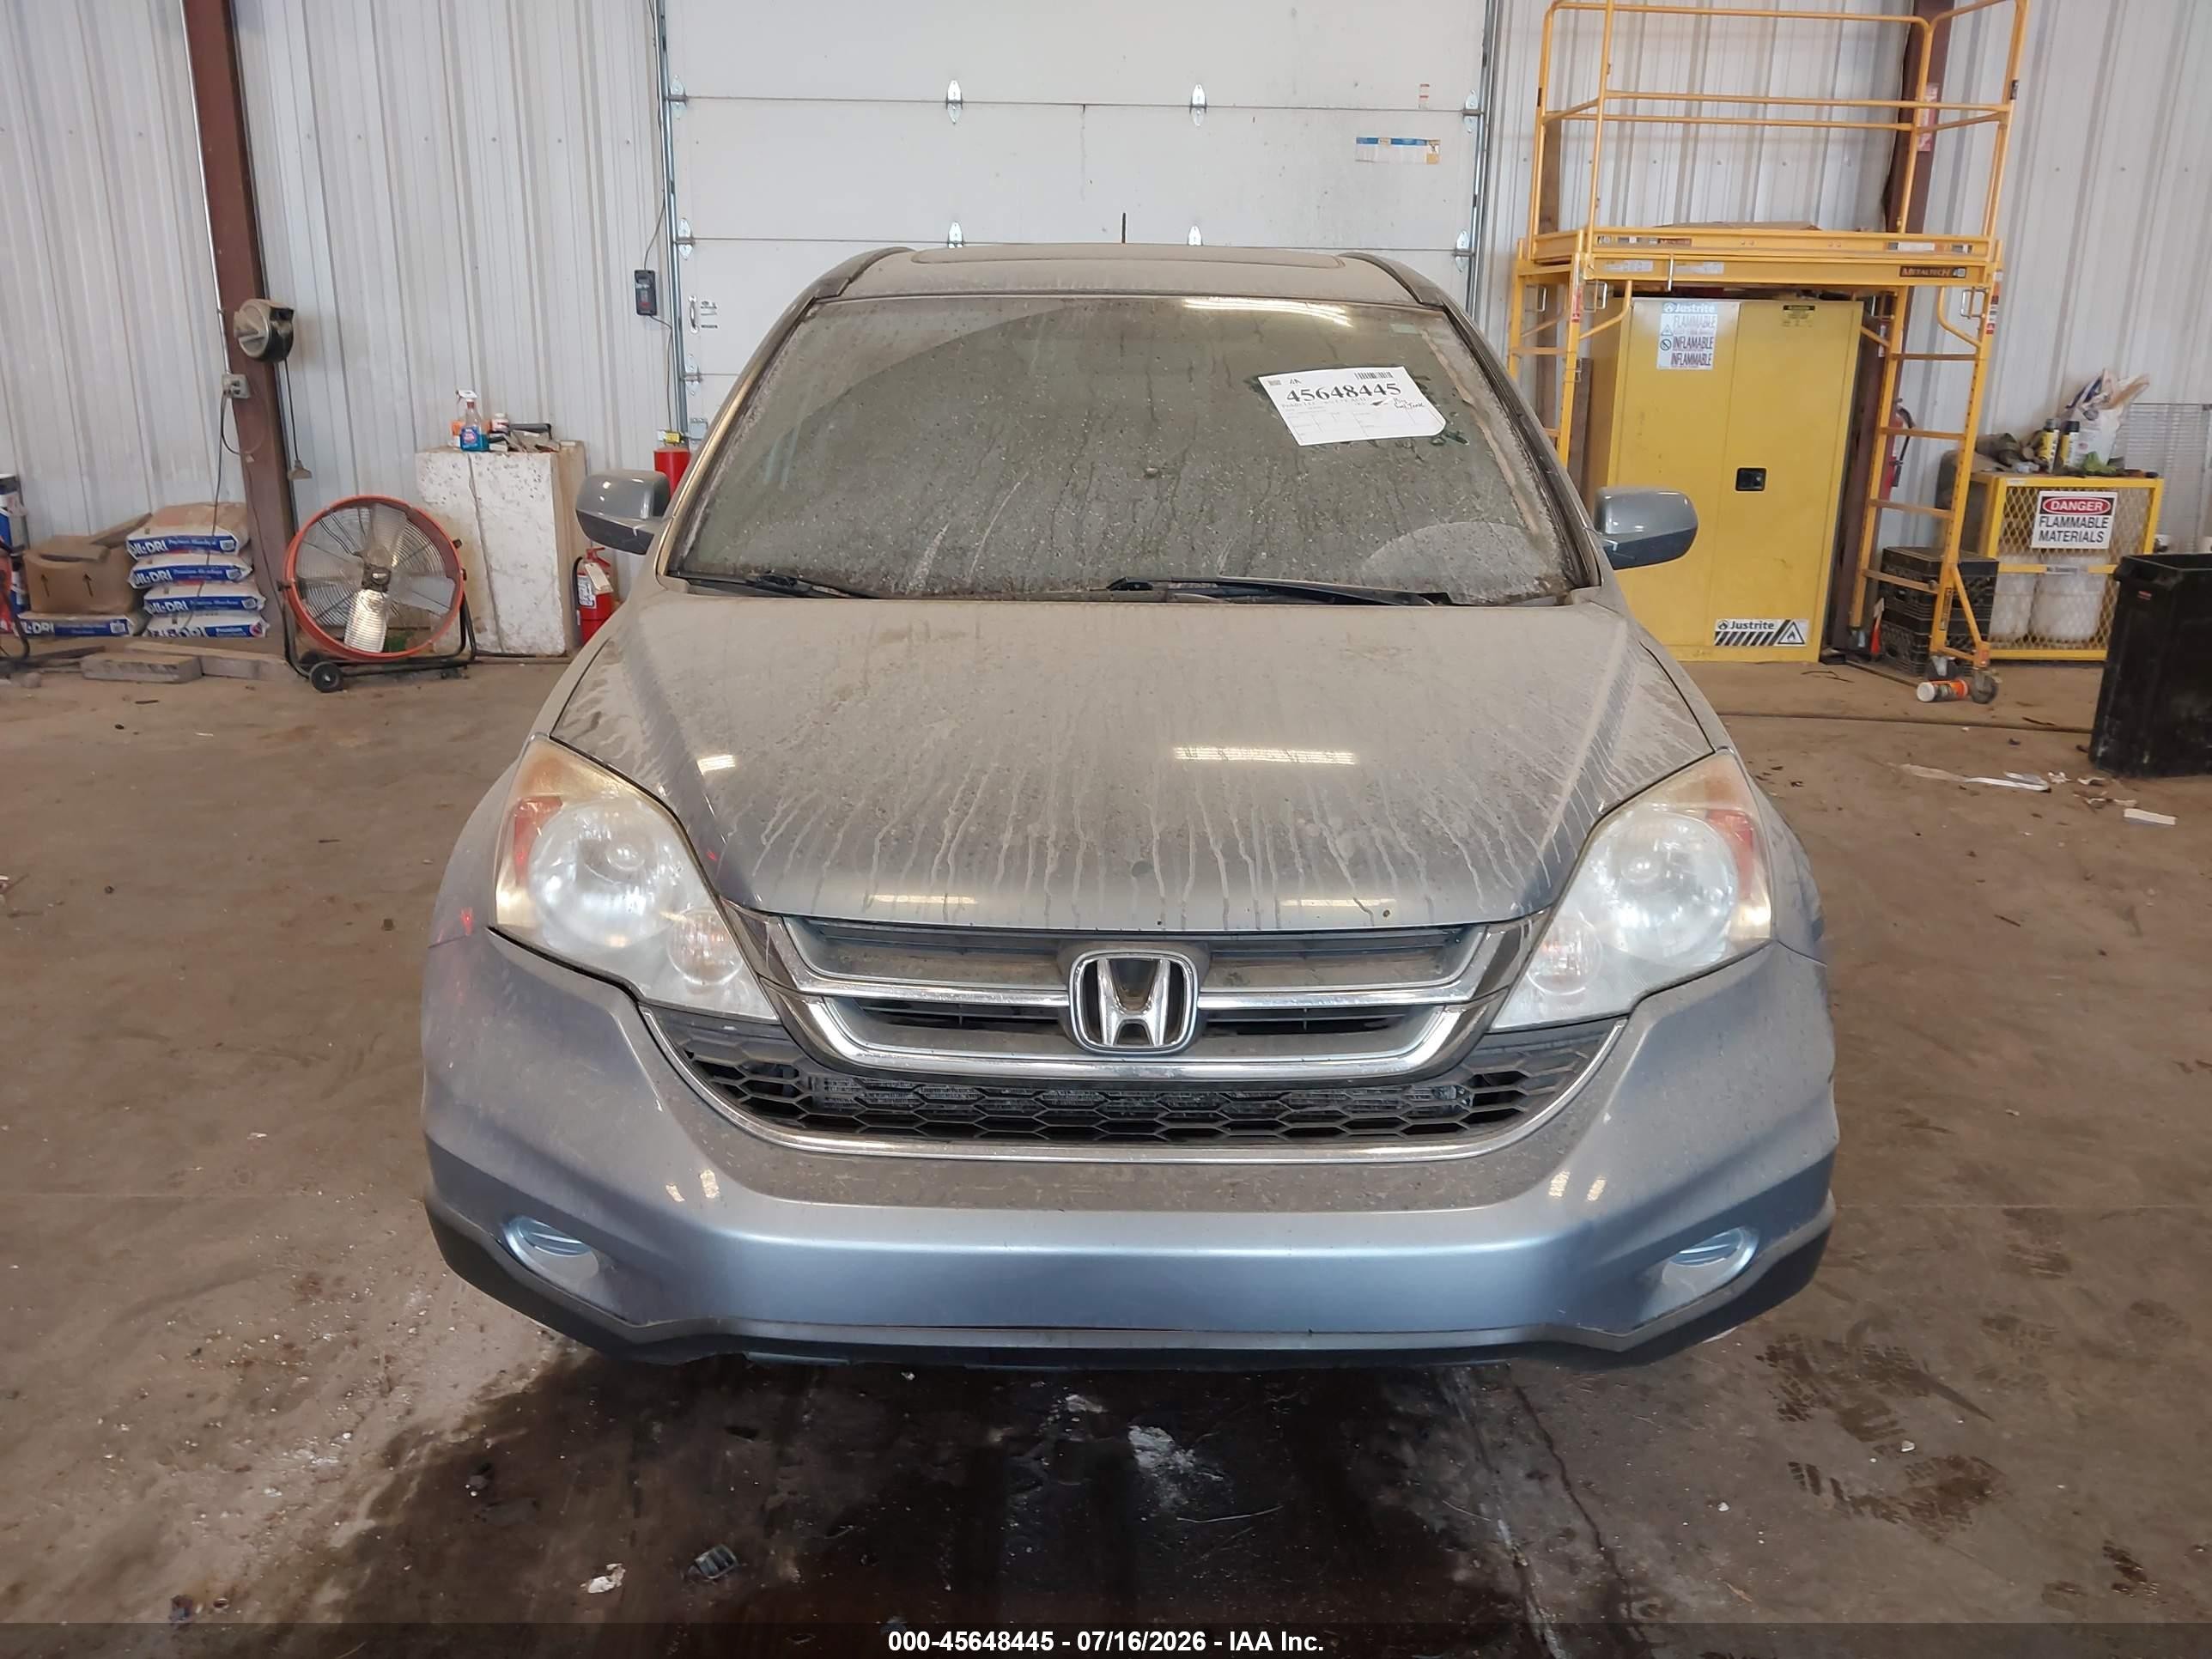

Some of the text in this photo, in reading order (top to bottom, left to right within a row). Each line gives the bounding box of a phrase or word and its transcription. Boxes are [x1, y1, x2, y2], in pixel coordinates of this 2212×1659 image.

[1286, 382, 1401, 403] 45648445
[2050, 501, 2104, 512] DANGER
[2039, 516, 2110, 529] FLAMMABLE
[2039, 530, 2104, 544] MATERIALS
[1730, 620, 1775, 630] Justrite
